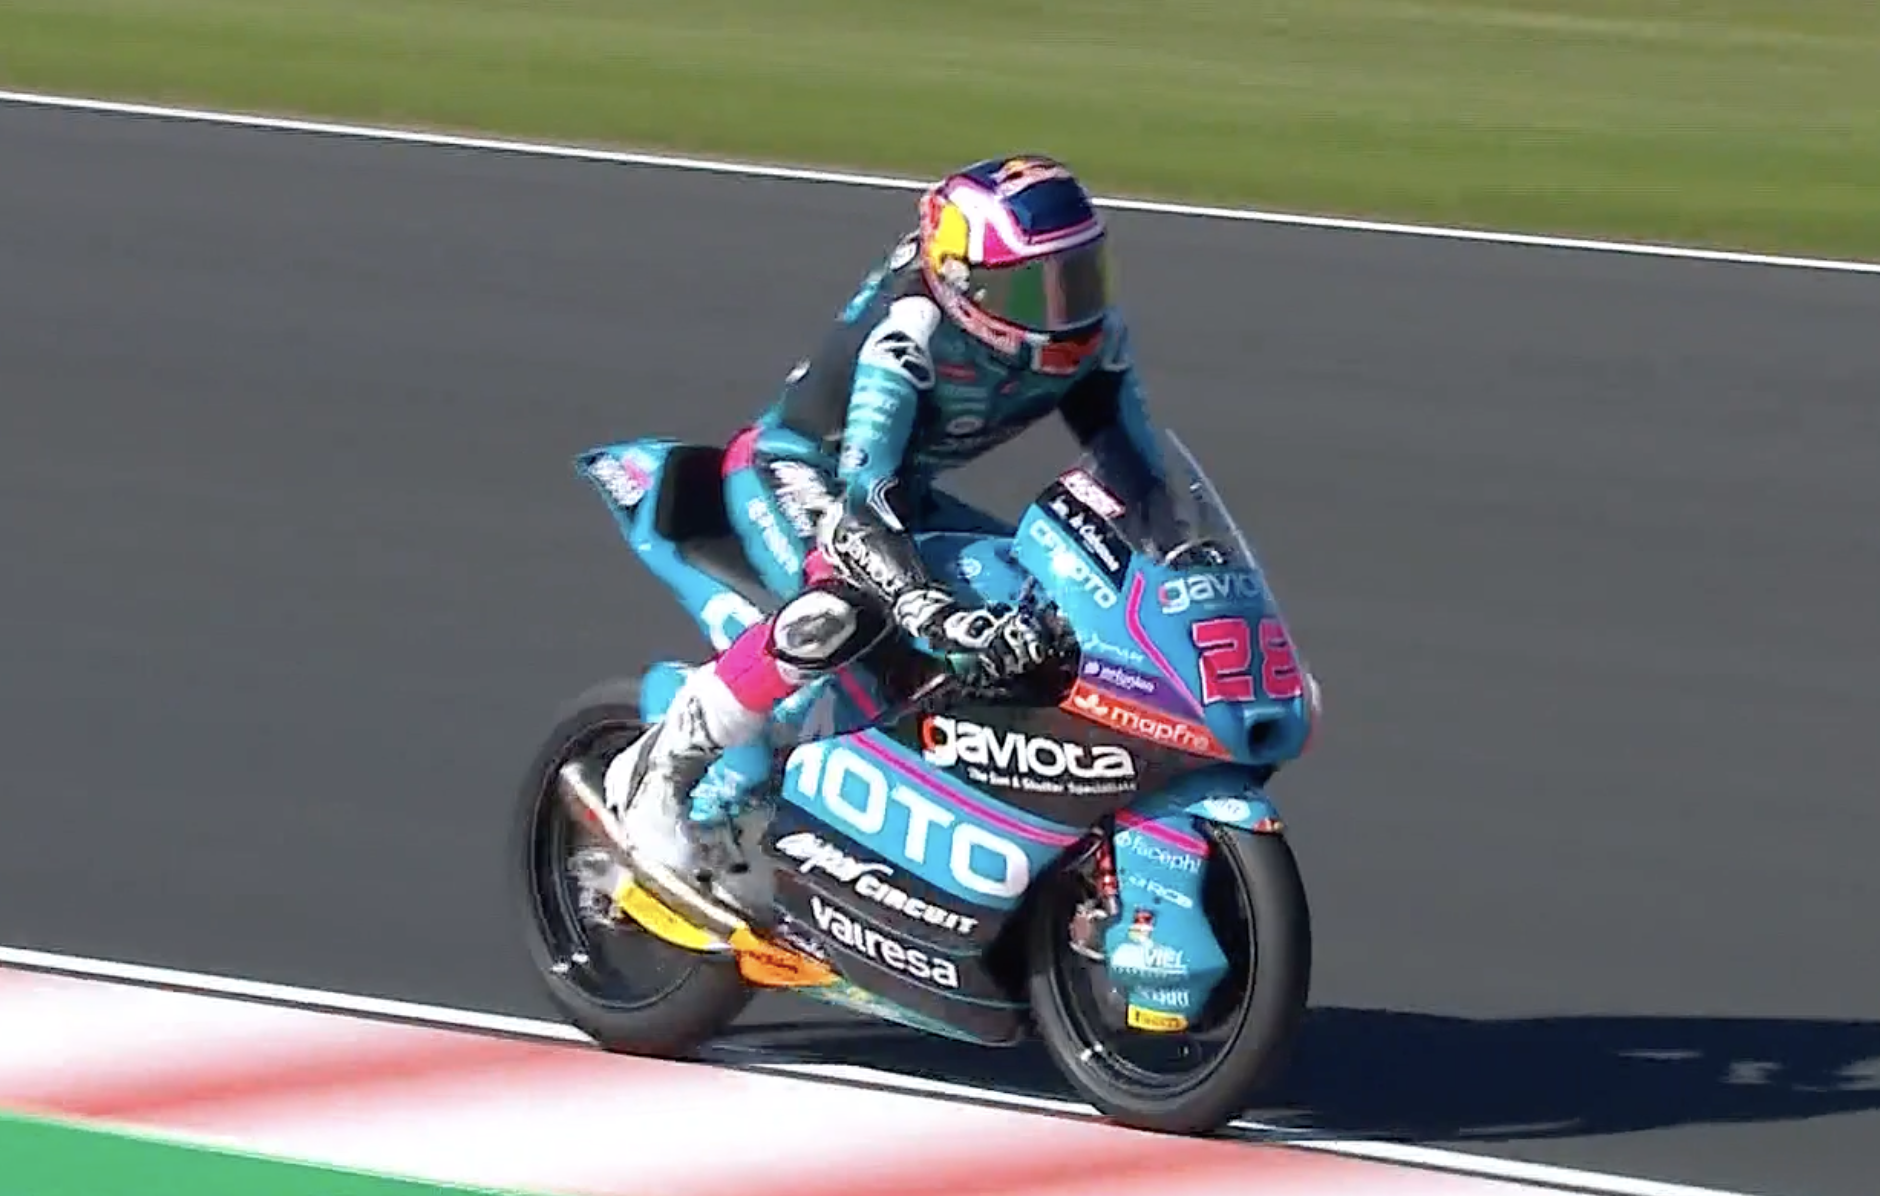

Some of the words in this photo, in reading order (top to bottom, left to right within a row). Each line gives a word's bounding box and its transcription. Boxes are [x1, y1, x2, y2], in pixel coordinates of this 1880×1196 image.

[1029, 519, 1118, 609] CFOTO
[1192, 616, 1303, 705] 28
[922, 713, 1136, 780] gaviota
[1110, 705, 1210, 751] mapfre
[854, 873, 980, 935] CIRCUIT
